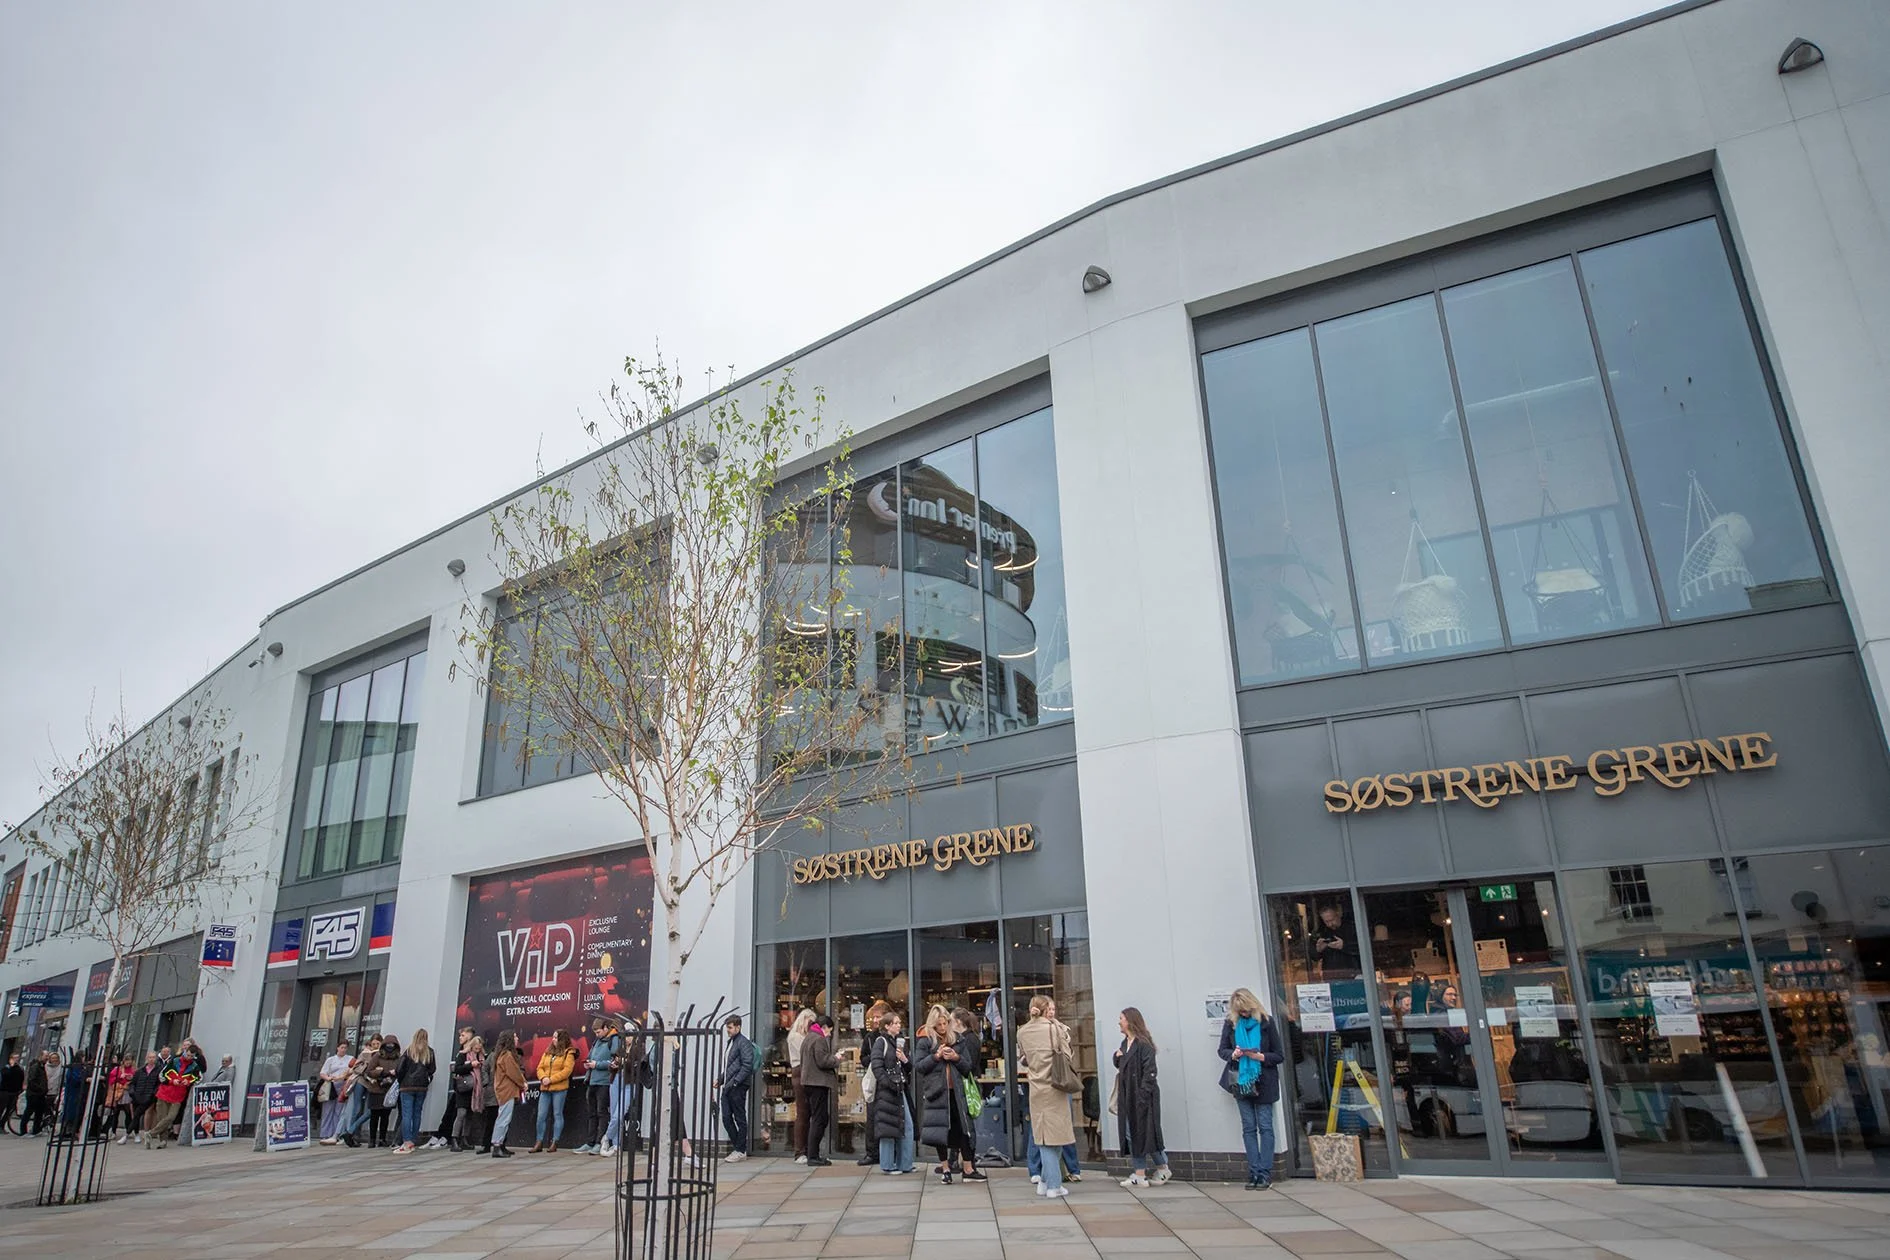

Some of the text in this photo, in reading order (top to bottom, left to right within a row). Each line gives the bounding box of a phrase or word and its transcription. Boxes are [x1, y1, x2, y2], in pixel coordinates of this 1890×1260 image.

[1323, 731, 1778, 814] SØSTRENE GRENE
[793, 823, 1035, 885] SØSTRENE GRENE
[588, 916, 618, 927] EXCLUSIVE
[210, 924, 237, 938] F45
[306, 906, 365, 961] F45
[588, 926, 611, 935] LOUNGE
[587, 939, 633, 951] COMPLIMENTARY
[585, 966, 614, 976] UNLIMITED
[585, 976, 607, 985] SNACKS
[490, 997, 507, 1006] MAKE
[513, 994, 538, 1005] SPECIAL
[538, 992, 571, 1003] OCCASION
[584, 993, 605, 1002] LUXURY
[506, 1005, 552, 1016] EXTRA SPECIAL
[583, 1002, 601, 1011] SEATS
[199, 1090, 226, 1102] 14 DAY
